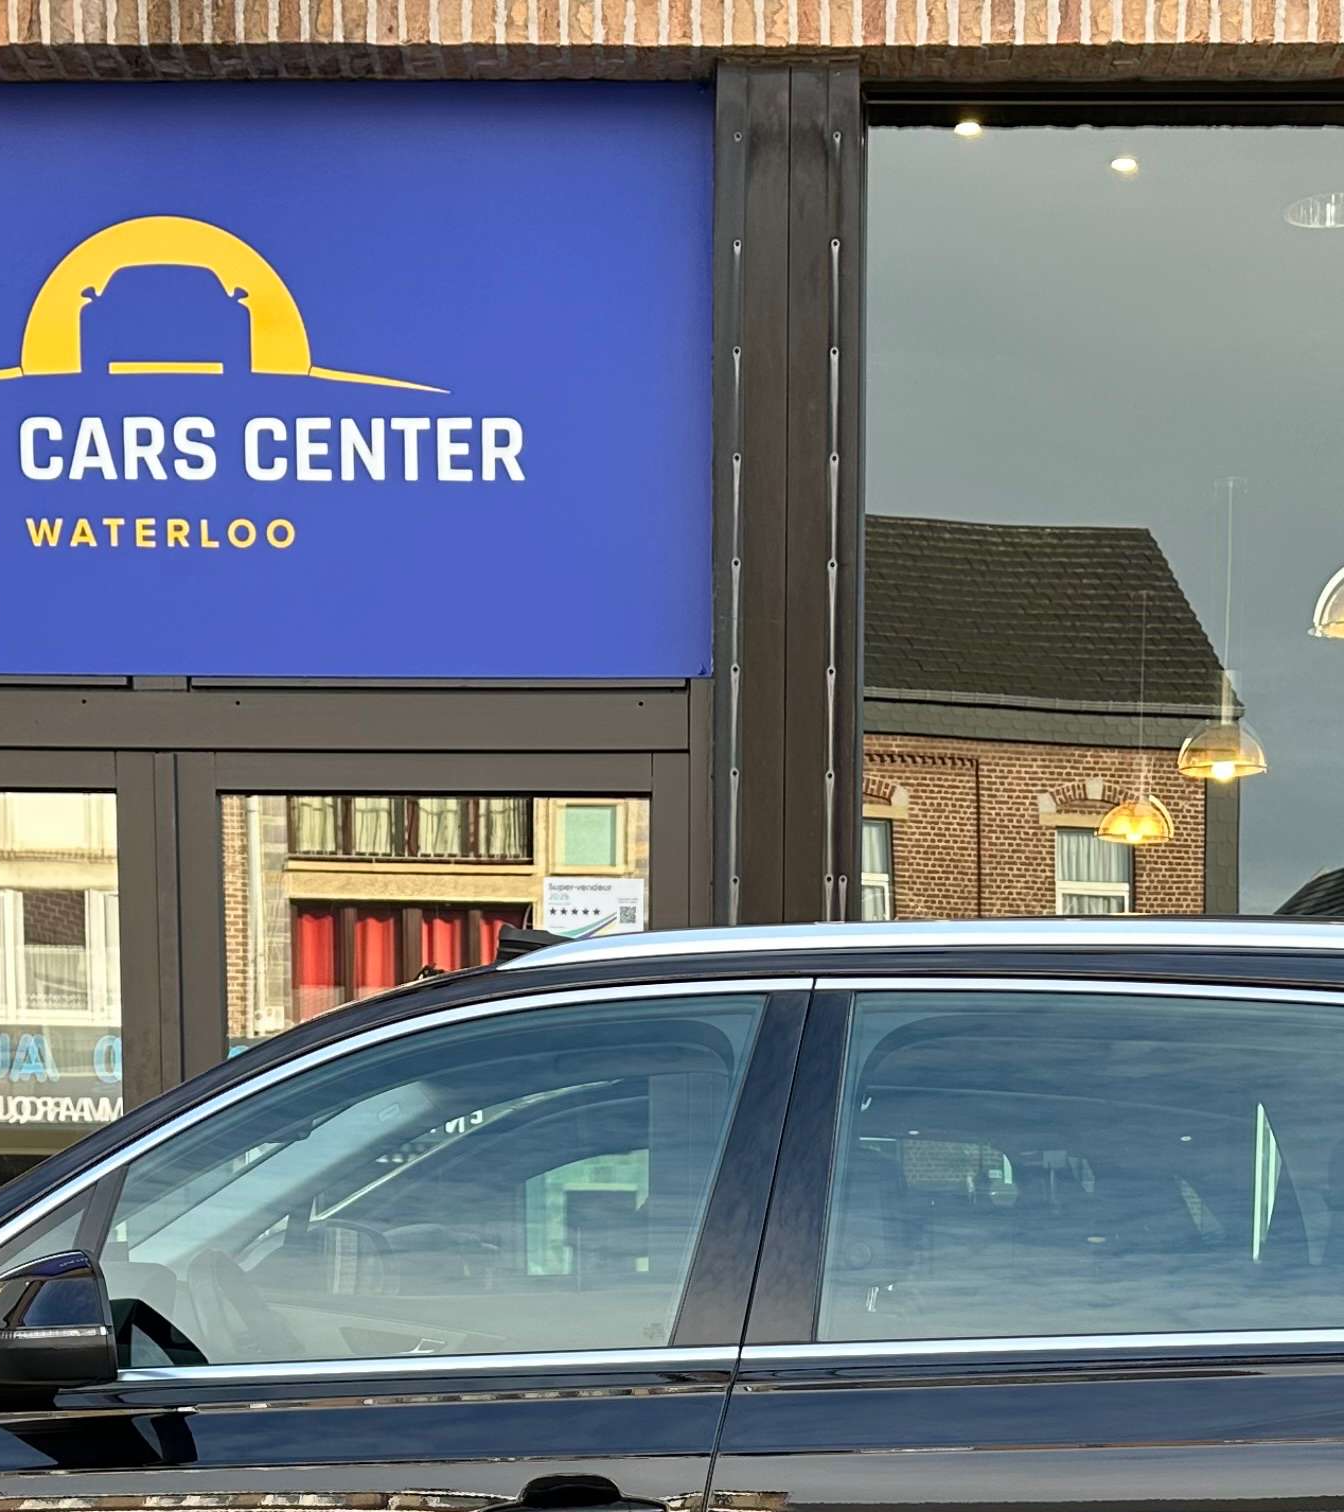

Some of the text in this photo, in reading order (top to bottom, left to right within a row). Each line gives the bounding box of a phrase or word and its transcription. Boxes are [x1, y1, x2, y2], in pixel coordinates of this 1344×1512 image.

[19, 416, 217, 481] CARS
[243, 416, 526, 482] CENTER
[26, 517, 296, 548] WATERLOO
